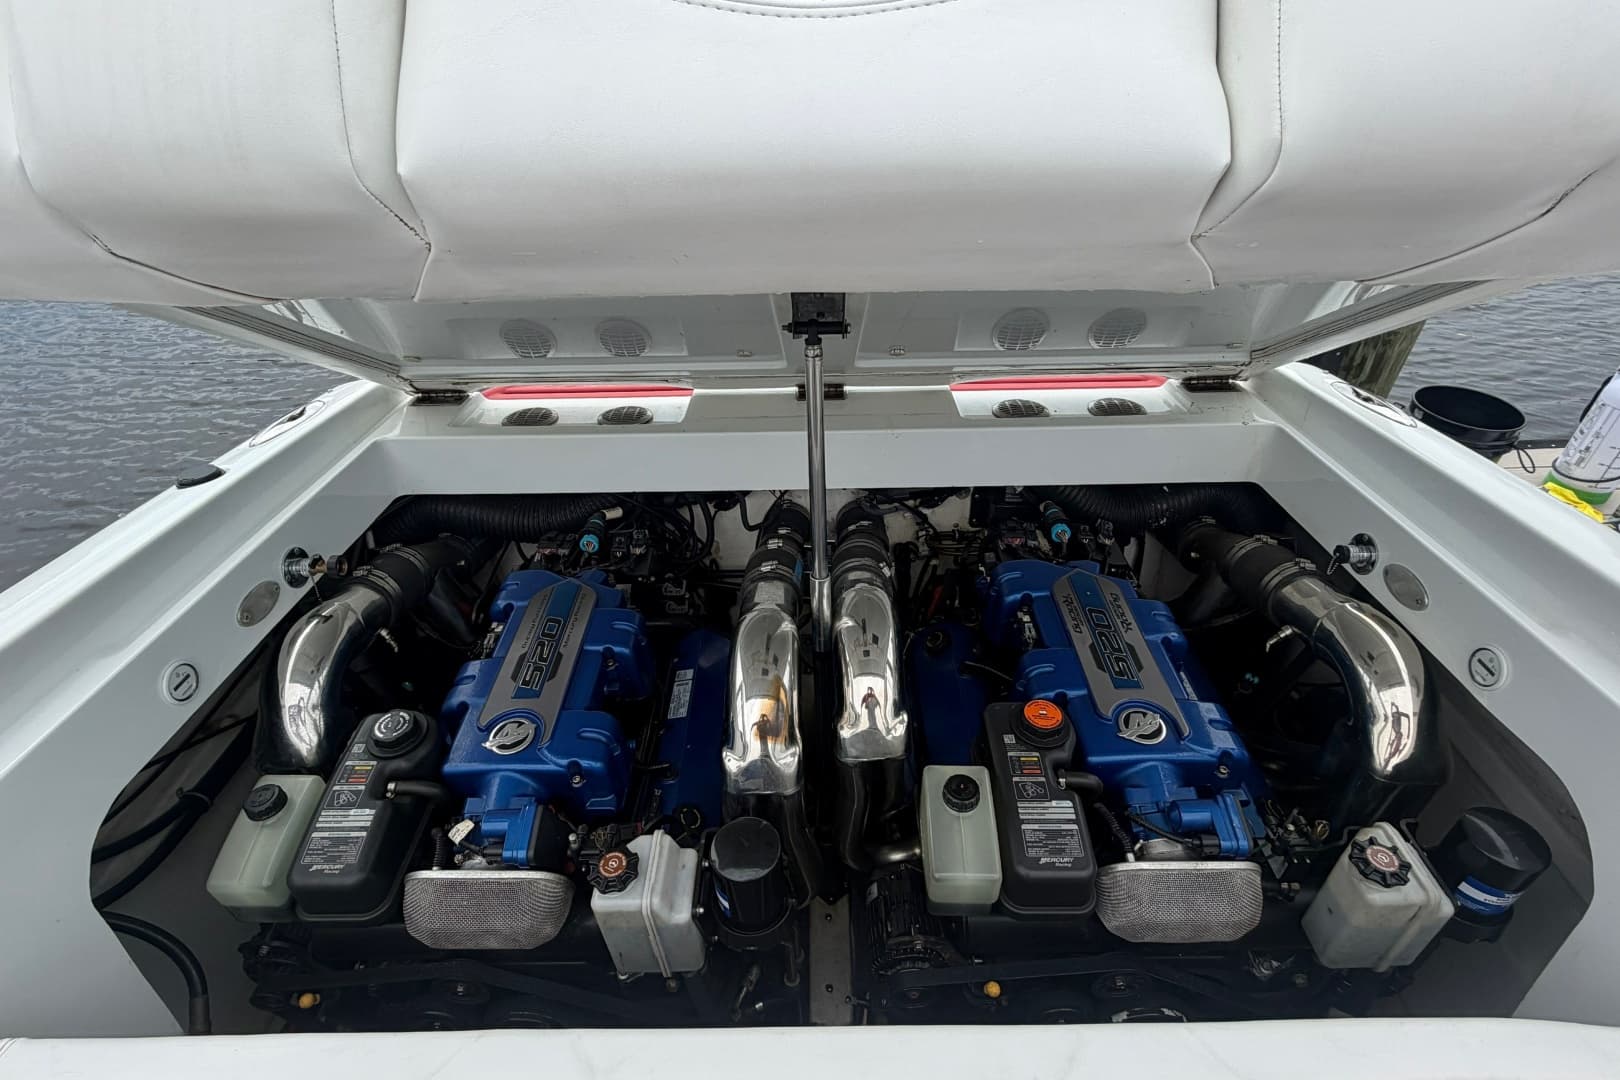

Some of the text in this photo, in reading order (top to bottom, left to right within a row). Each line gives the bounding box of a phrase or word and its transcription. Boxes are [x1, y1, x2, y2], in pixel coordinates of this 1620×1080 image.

[1062, 593, 1083, 634] Racing
[519, 618, 564, 690] 520
[1086, 607, 1138, 681] 520
[1039, 857, 1074, 865] MERCURY
